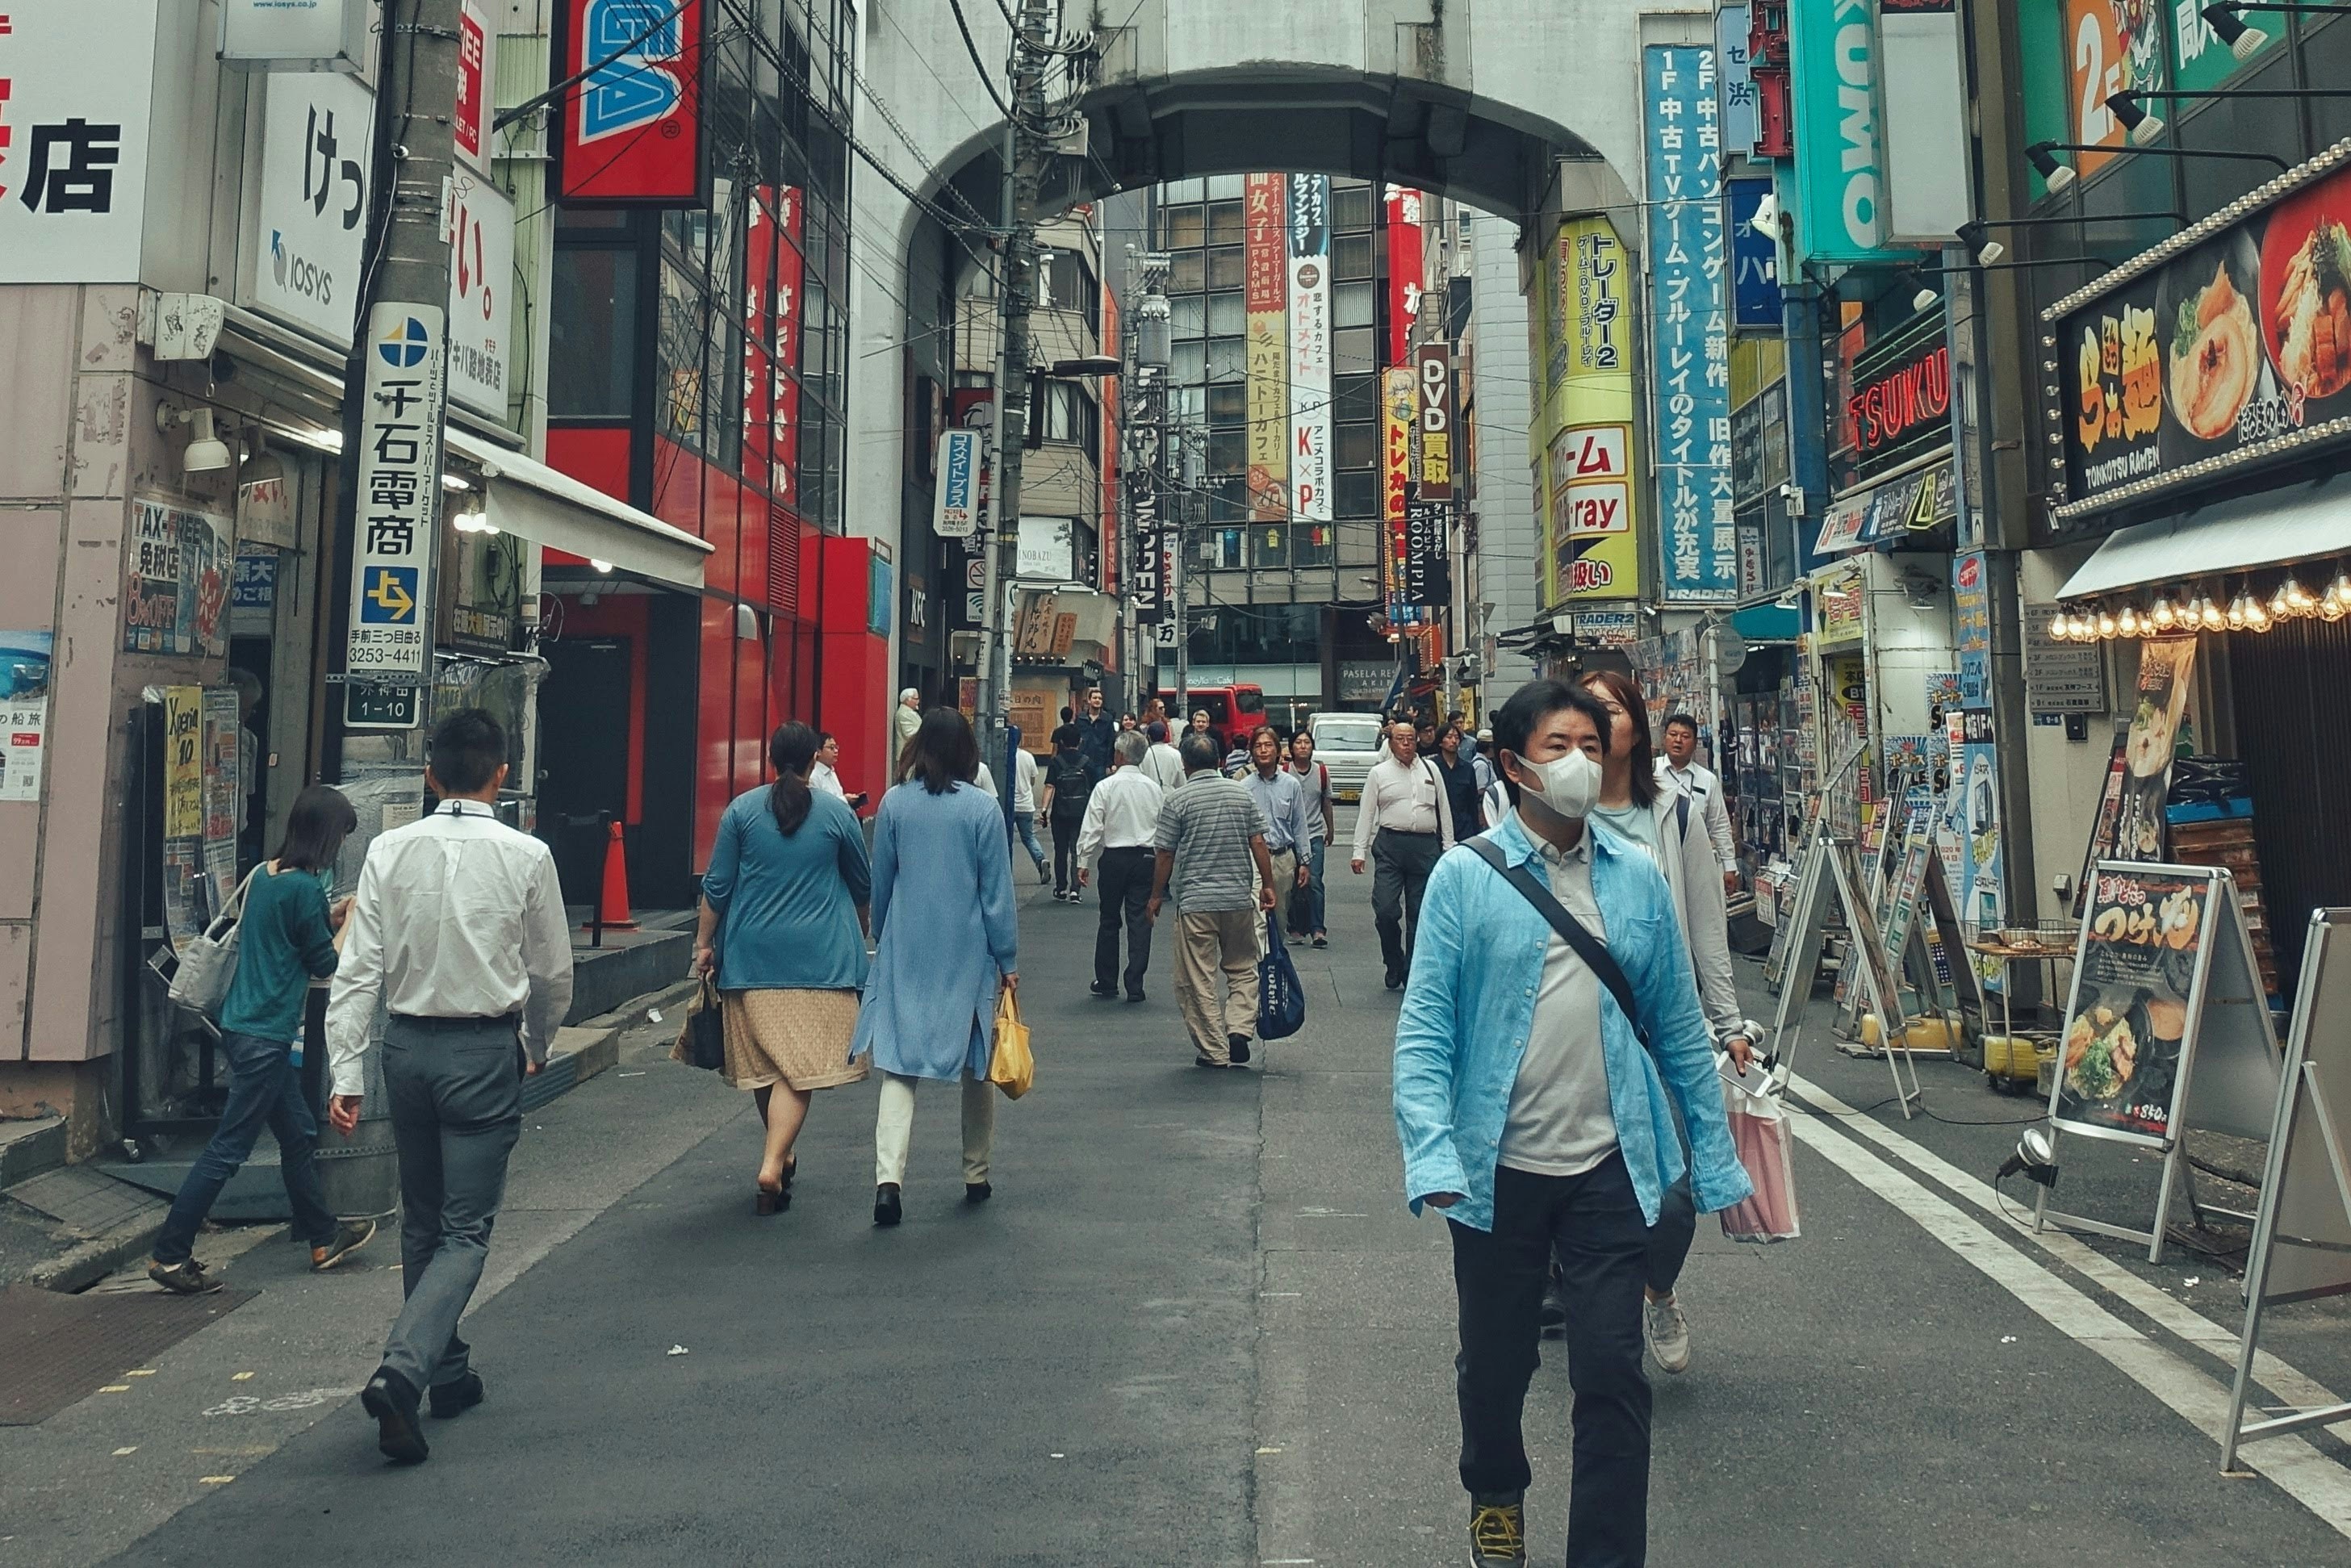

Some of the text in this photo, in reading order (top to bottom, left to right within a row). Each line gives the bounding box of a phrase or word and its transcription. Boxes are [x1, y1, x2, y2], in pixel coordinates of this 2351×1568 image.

[253, 0, 317, 9] www.iosys.co.jp
[2077, 13, 2120, 152] 2F
[20, 118, 121, 213] 店
[290, 252, 333, 306] IOSYS
[1592, 233, 1618, 369] トレーダー2
[1297, 293, 1311, 376] オトメイト
[1254, 353, 1270, 461] ハニトーカフェ
[367, 379, 422, 556] 千石電商
[949, 434, 968, 508] コスメイトプラス
[1314, 425, 1325, 514] アニメコラボカフェ
[2085, 445, 2161, 489] TONKOTSU RAMEN
[1410, 508, 1424, 601] ROOMPIA
[910, 588, 927, 629] KFC
[1575, 613, 1636, 624] TRADER2
[349, 646, 420, 664] 3253-4411
[351, 629, 421, 644] 手前三つ目曲る
[1343, 669, 1377, 678] PASELA
[167, 696, 199, 739] Xperia
[179, 738, 194, 767] 10
[1267, 965, 1279, 1016] volvic
